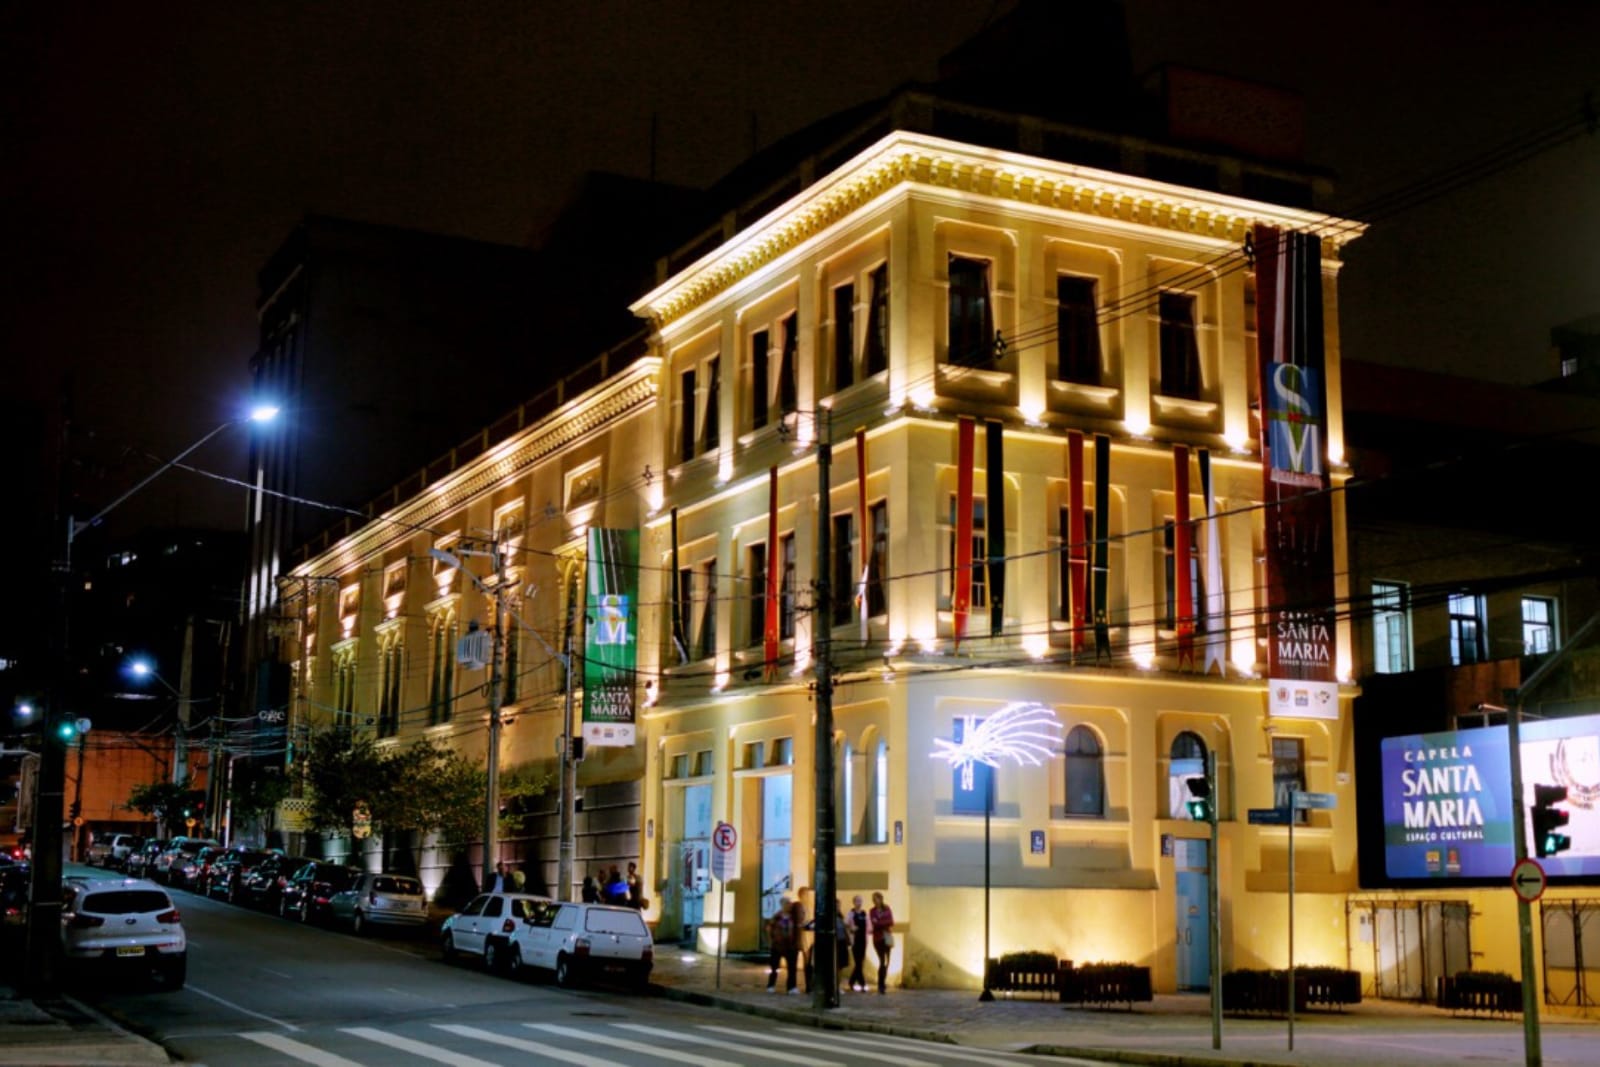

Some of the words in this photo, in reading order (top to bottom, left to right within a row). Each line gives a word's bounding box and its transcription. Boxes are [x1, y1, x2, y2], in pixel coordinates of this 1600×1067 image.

[1277, 621, 1329, 641] SANTA
[1278, 641, 1330, 661] MARIA
[591, 690, 631, 704] SANTA
[591, 703, 631, 716] MARIA
[1404, 745, 1472, 762] CAPELA
[1402, 764, 1481, 797] SANTA
[1403, 798, 1484, 829] MARIA
[1406, 832, 1437, 843] ESPAÇO
[1440, 830, 1484, 841] CULTURAL
